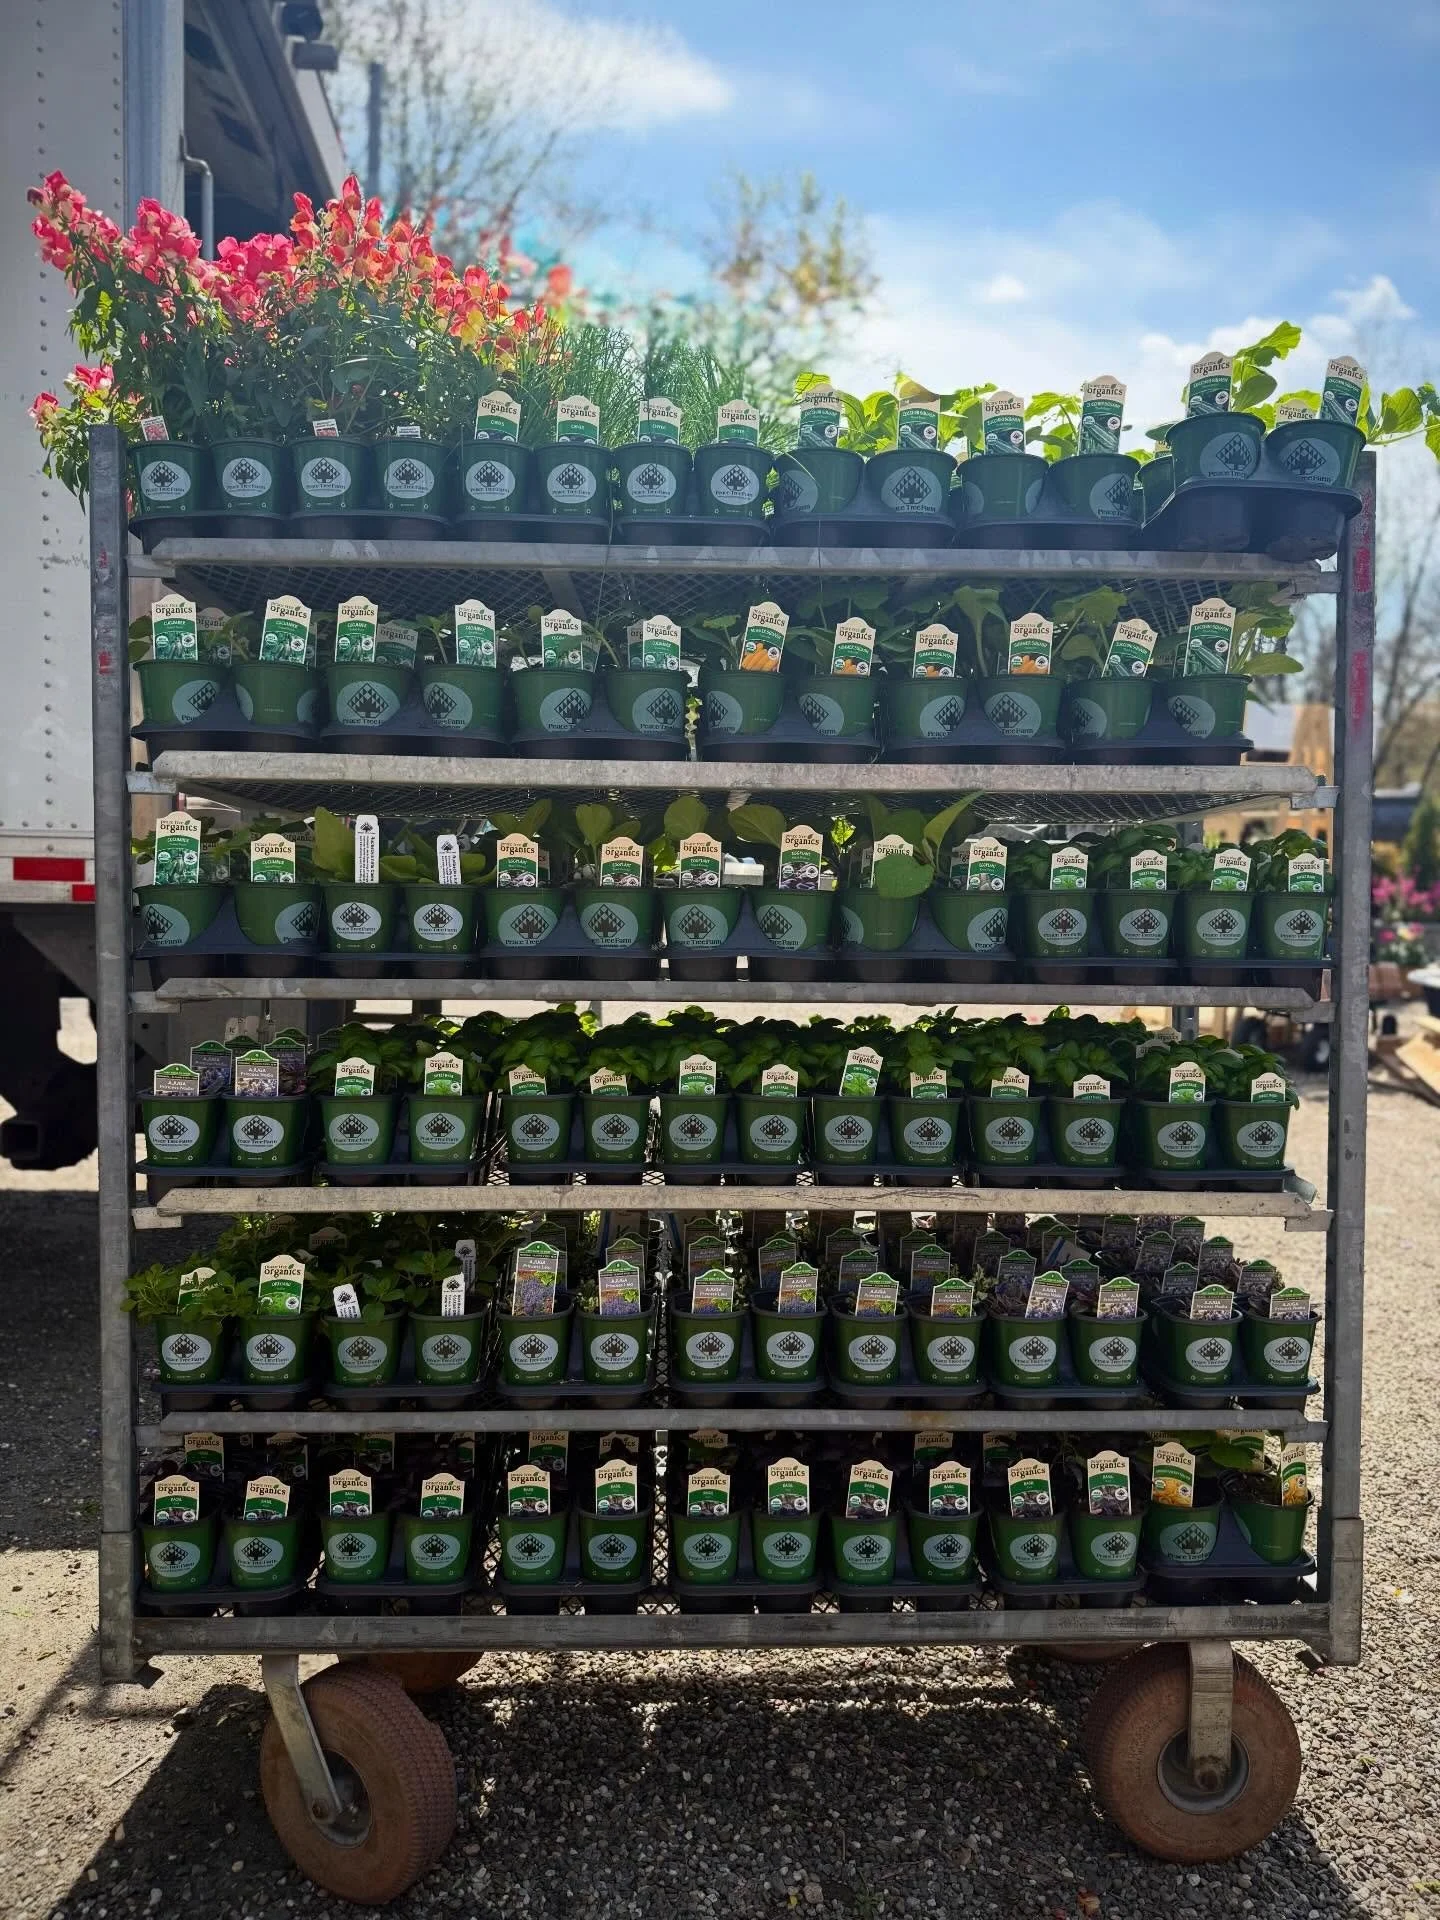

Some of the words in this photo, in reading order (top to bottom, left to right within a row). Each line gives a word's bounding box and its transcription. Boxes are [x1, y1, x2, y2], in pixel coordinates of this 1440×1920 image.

[1193, 362, 1230, 375] organics
[1330, 363, 1363, 380] organics
[1087, 385, 1123, 397] organics
[482, 402, 518, 415] organics
[643, 405, 678, 420] organics
[985, 402, 1021, 414] organics
[560, 408, 596, 418] organics
[721, 412, 757, 422] organics
[1280, 409, 1313, 419] organics
[155, 606, 193, 616] organics
[270, 605, 307, 619] organics
[341, 608, 374, 618] organics
[1195, 611, 1232, 620] organics
[458, 611, 492, 621] organics
[752, 612, 785, 626] organics
[544, 622, 579, 631] organics
[1014, 626, 1050, 636] organics
[380, 629, 415, 641] organics
[647, 626, 678, 637] organics
[839, 630, 872, 640] organics
[1119, 627, 1153, 642] organics
[919, 637, 954, 647] organics
[160, 824, 198, 833] organics
[785, 838, 819, 847] organics
[254, 845, 292, 854] organics
[501, 846, 534, 855] organics
[606, 850, 639, 858] organics
[684, 845, 718, 854] organics
[974, 850, 1004, 859] organics
[1057, 857, 1084, 865] organics
[341, 1067, 370, 1075] organics
[1256, 1082, 1282, 1090] organics
[264, 1269, 301, 1277] organics
[188, 1439, 219, 1448] organics
[532, 1435, 565, 1443] organics
[1157, 1453, 1192, 1465] organics
[1283, 1451, 1304, 1463] organics
[1090, 1463, 1125, 1471] organics
[599, 1471, 633, 1481] organics
[771, 1470, 805, 1479] organics
[854, 1470, 888, 1480] organics
[933, 1473, 967, 1481] organics
[1011, 1469, 1045, 1478] organics
[333, 1480, 367, 1488] organics
[511, 1476, 546, 1484] organics
[692, 1478, 726, 1487] organics
[158, 1486, 195, 1494] organics
[250, 1486, 286, 1495] organics
[425, 1485, 460, 1493] organics
